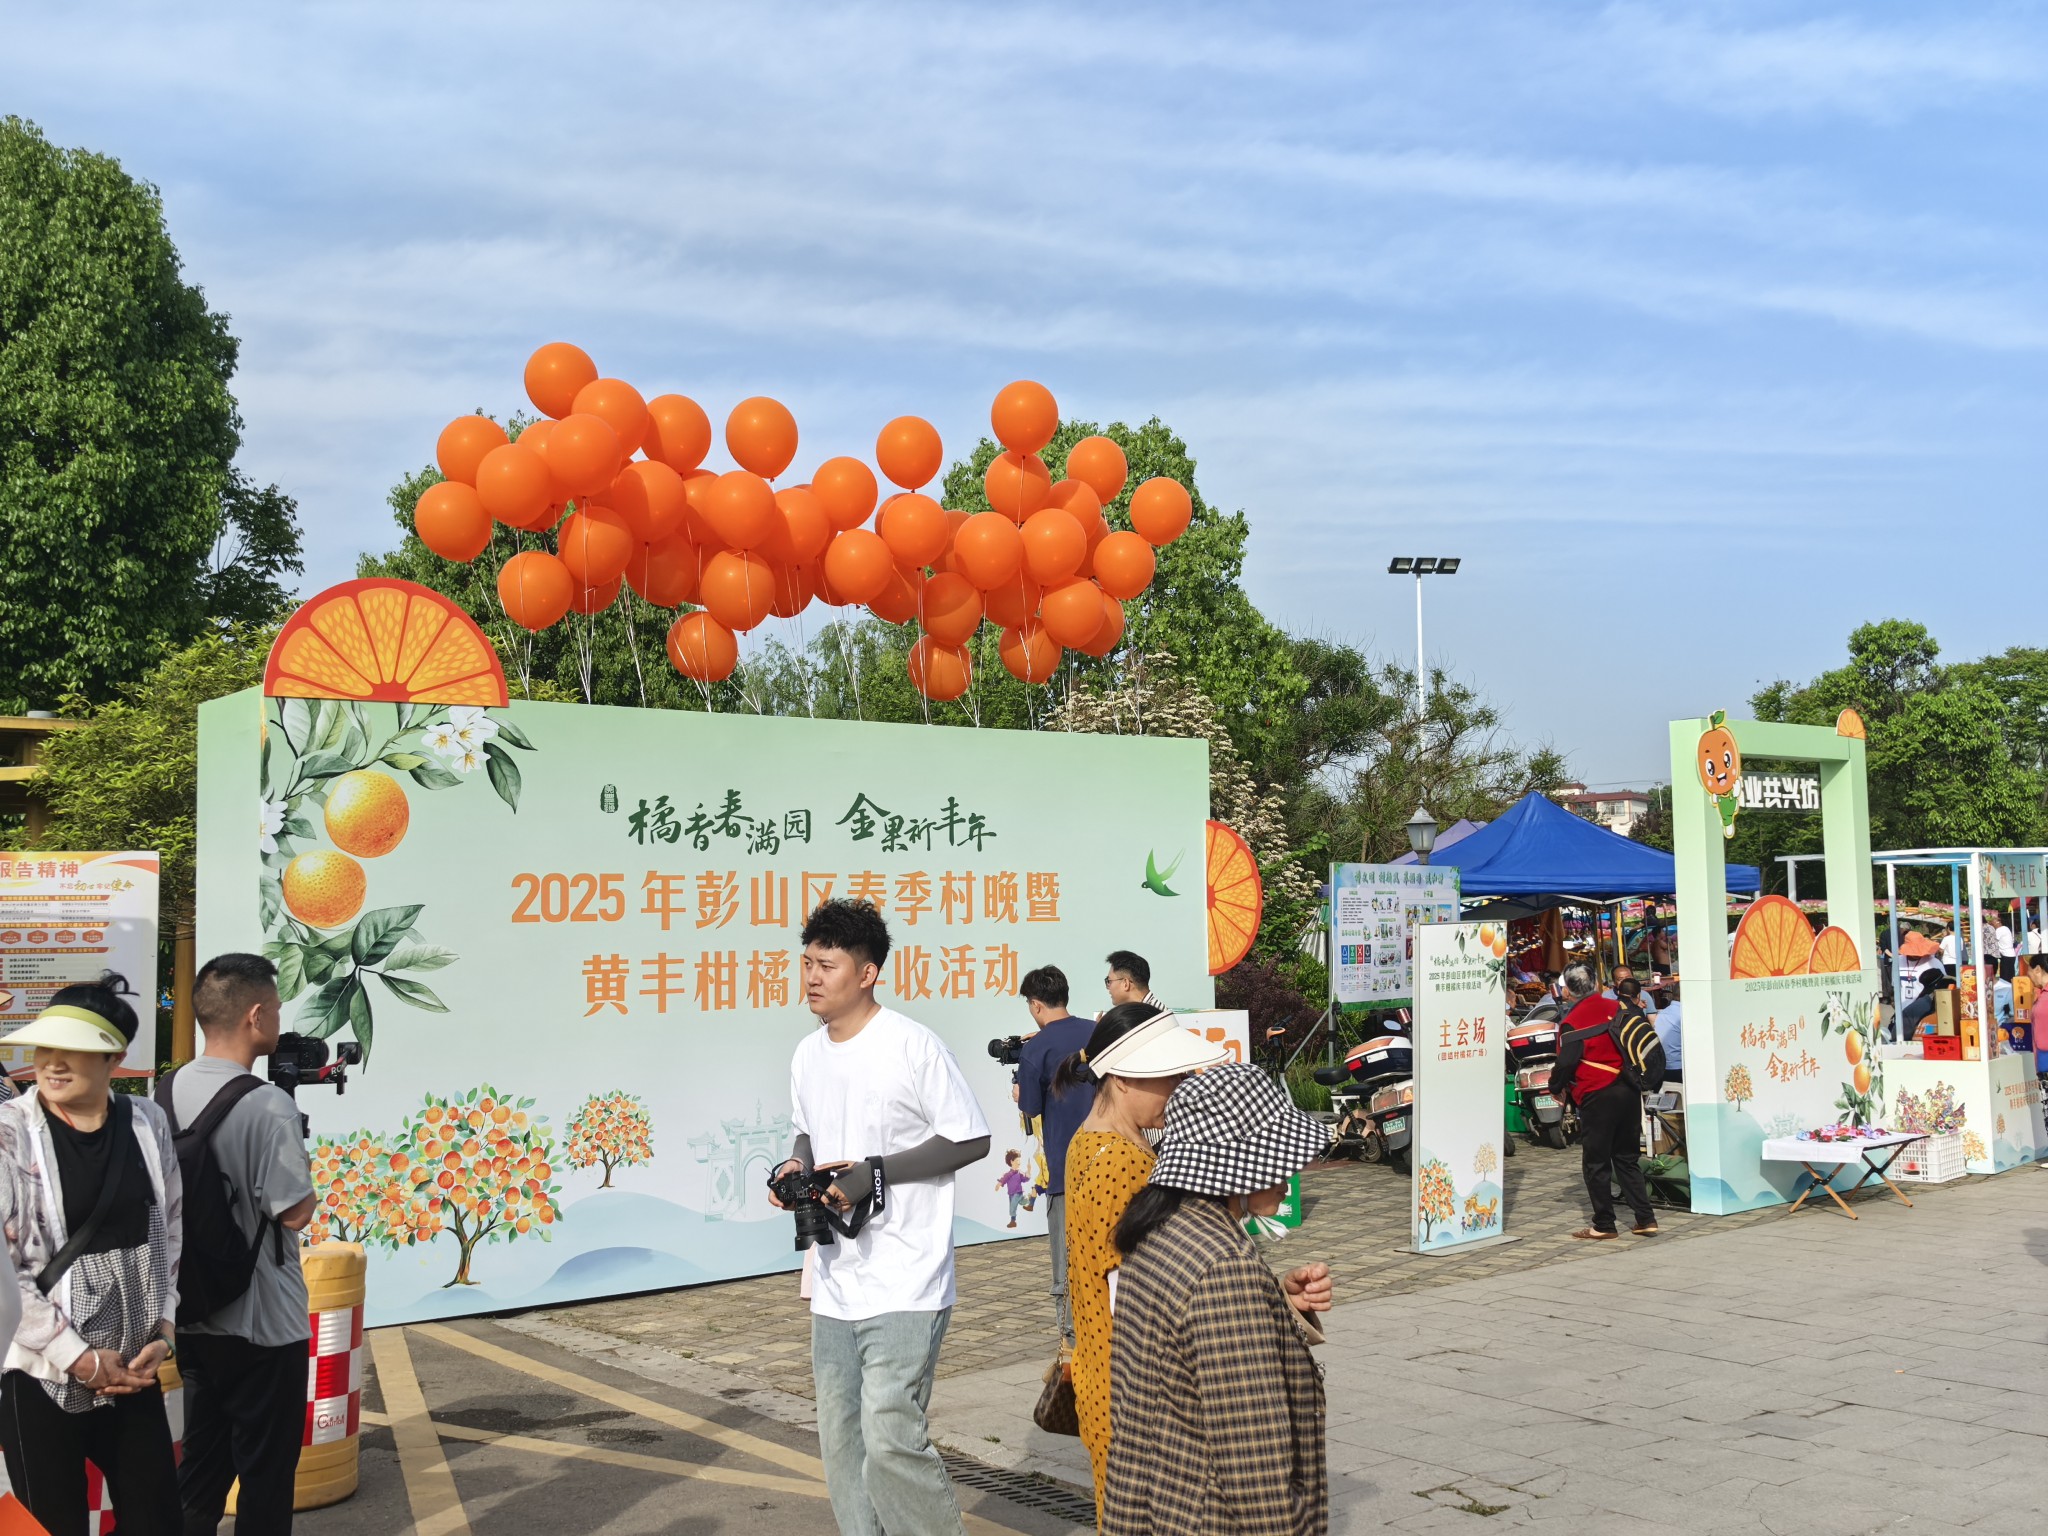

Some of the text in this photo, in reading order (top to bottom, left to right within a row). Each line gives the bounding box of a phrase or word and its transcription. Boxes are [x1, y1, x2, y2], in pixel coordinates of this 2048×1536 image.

[1739, 776, 1819, 809] 业共兴坊
[628, 789, 811, 856] 橘香春满园
[835, 792, 997, 852] 金果祈丰年
[0, 861, 78, 878] 报告精神
[511, 870, 1061, 930] 2025年彭山区春季村晚暨
[582, 943, 1019, 1017] 黄丰柑橘收活动
[1439, 1017, 1486, 1048] 主会场
[1741, 1016, 1797, 1049] 橘香春满园
[1765, 1049, 1821, 1083] 金果祈丰年
[874, 1168, 883, 1206] SONY
